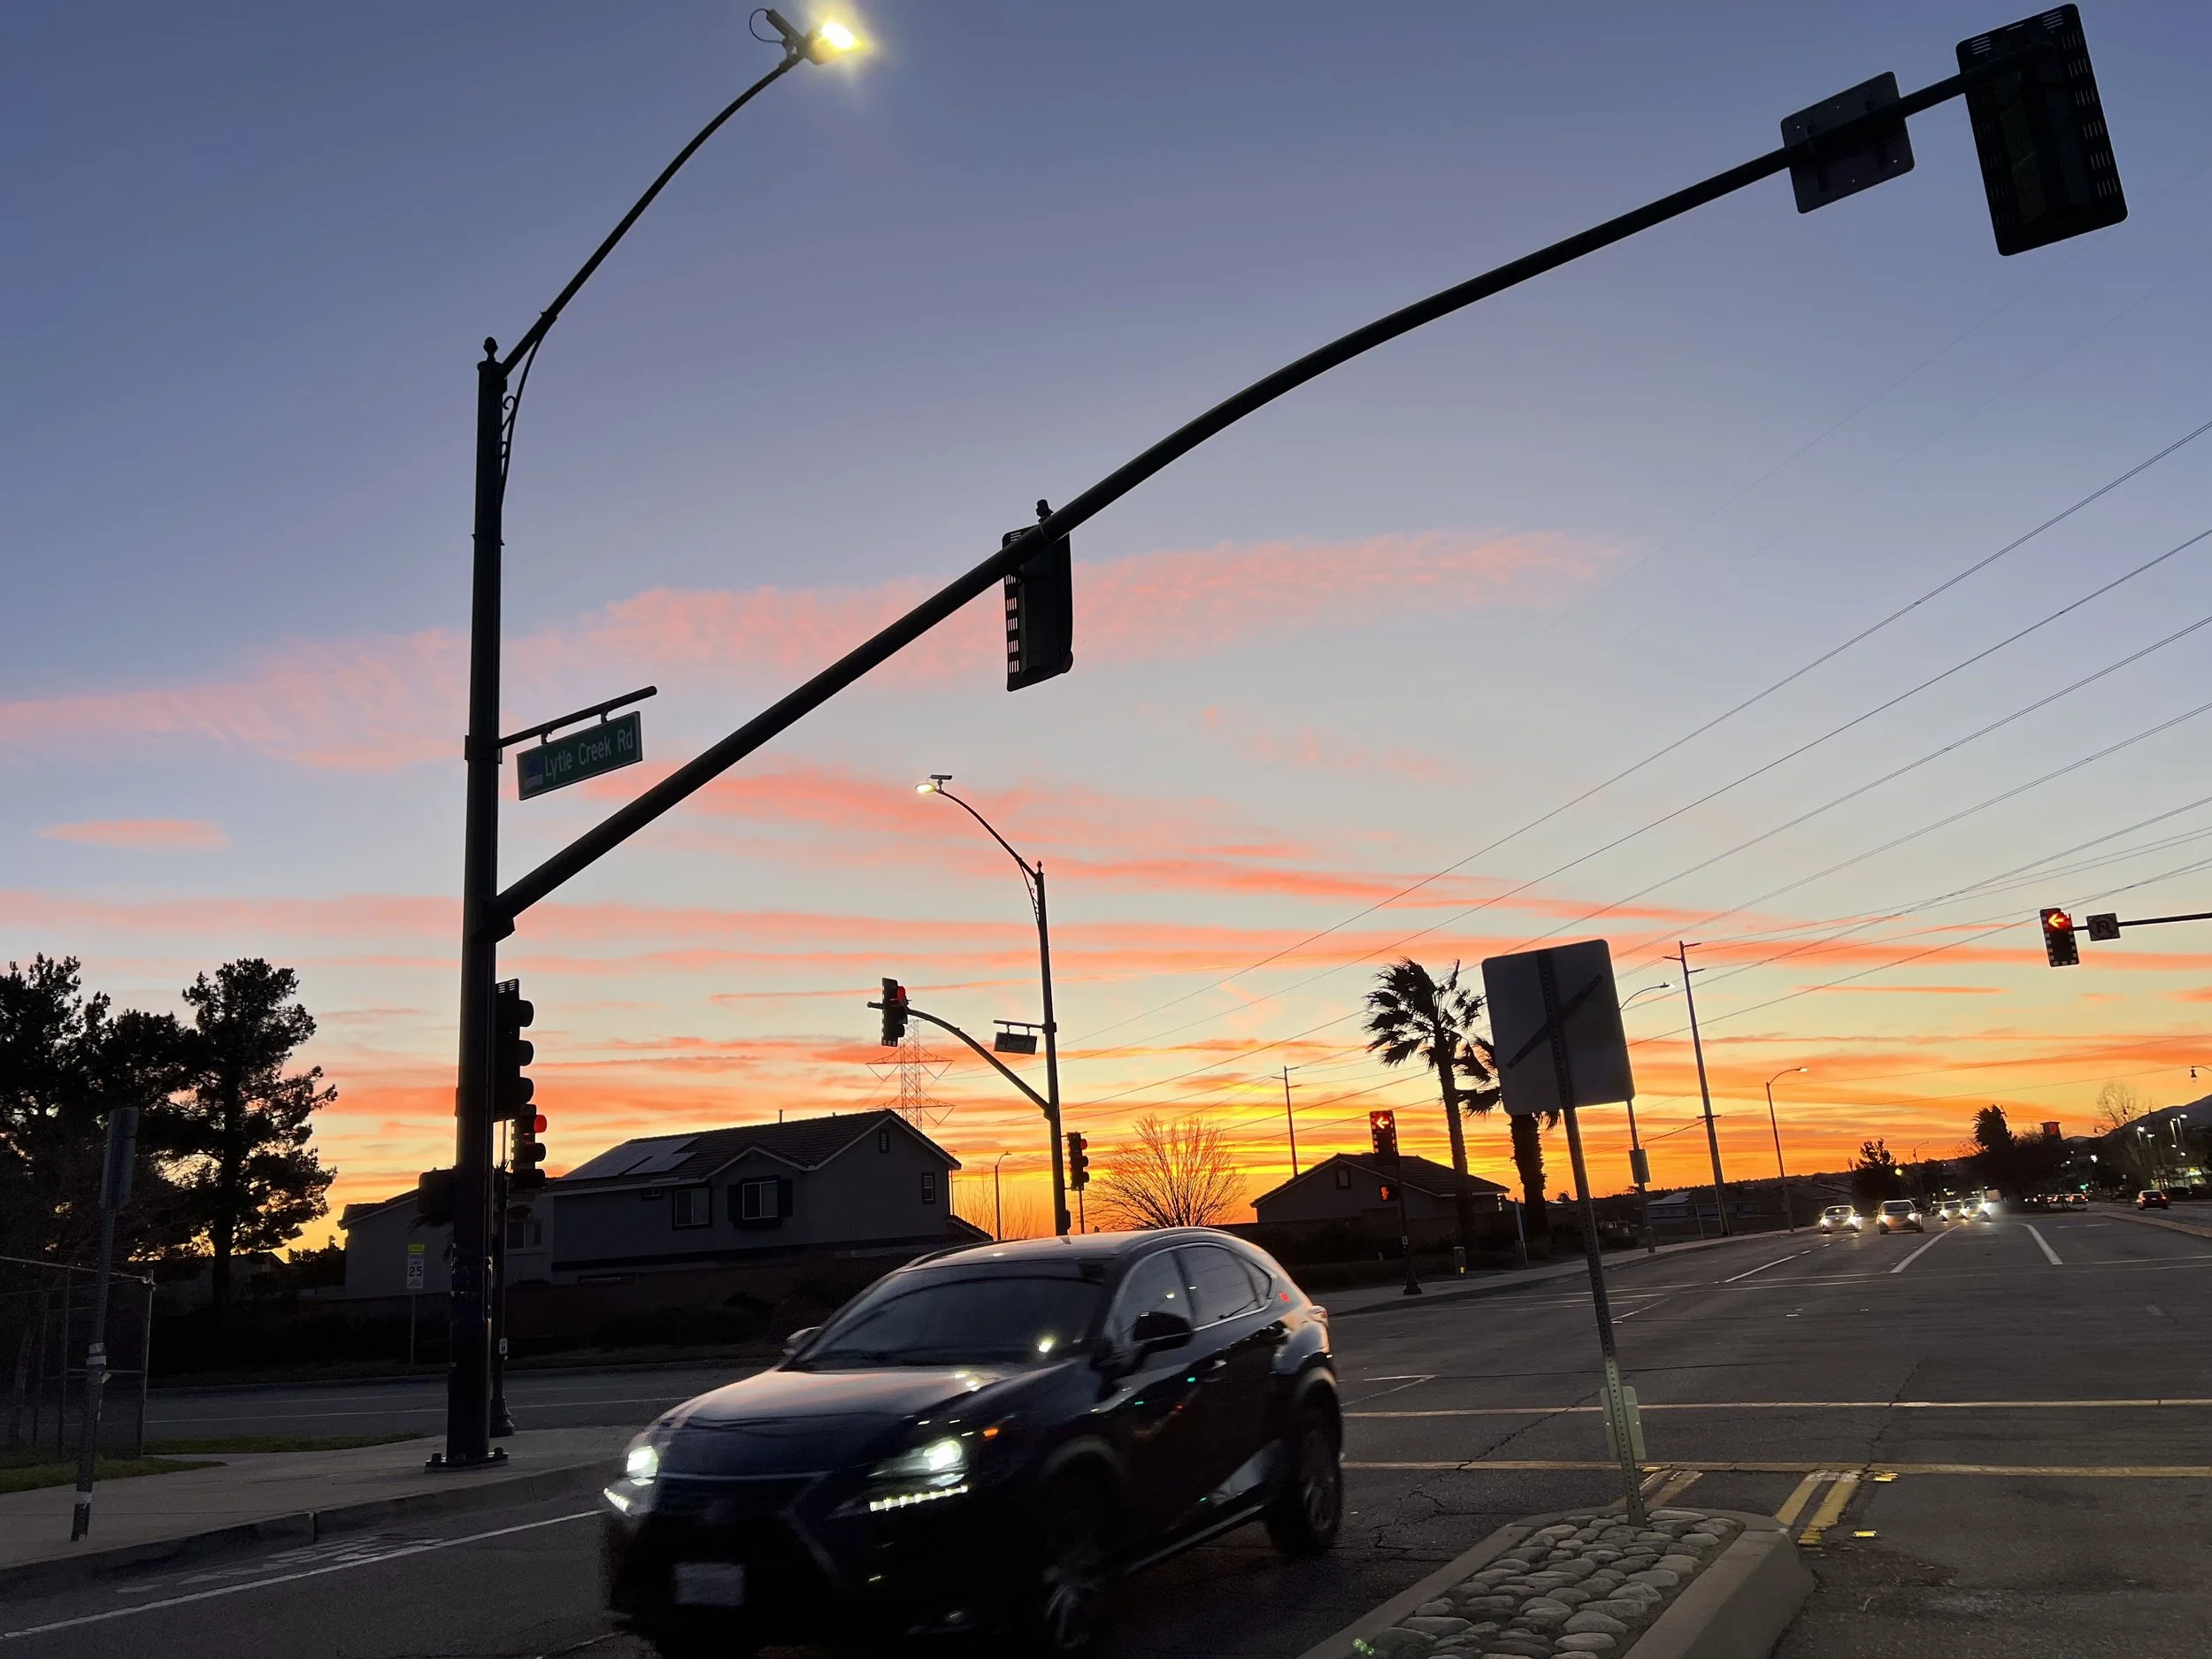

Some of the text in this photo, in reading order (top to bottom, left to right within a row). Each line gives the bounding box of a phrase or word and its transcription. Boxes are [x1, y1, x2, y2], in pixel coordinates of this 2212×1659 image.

[545, 750, 572, 780] Lytle
[578, 735, 612, 765] Creek
[618, 726, 634, 751] Rd
[409, 1266, 423, 1277] 25
